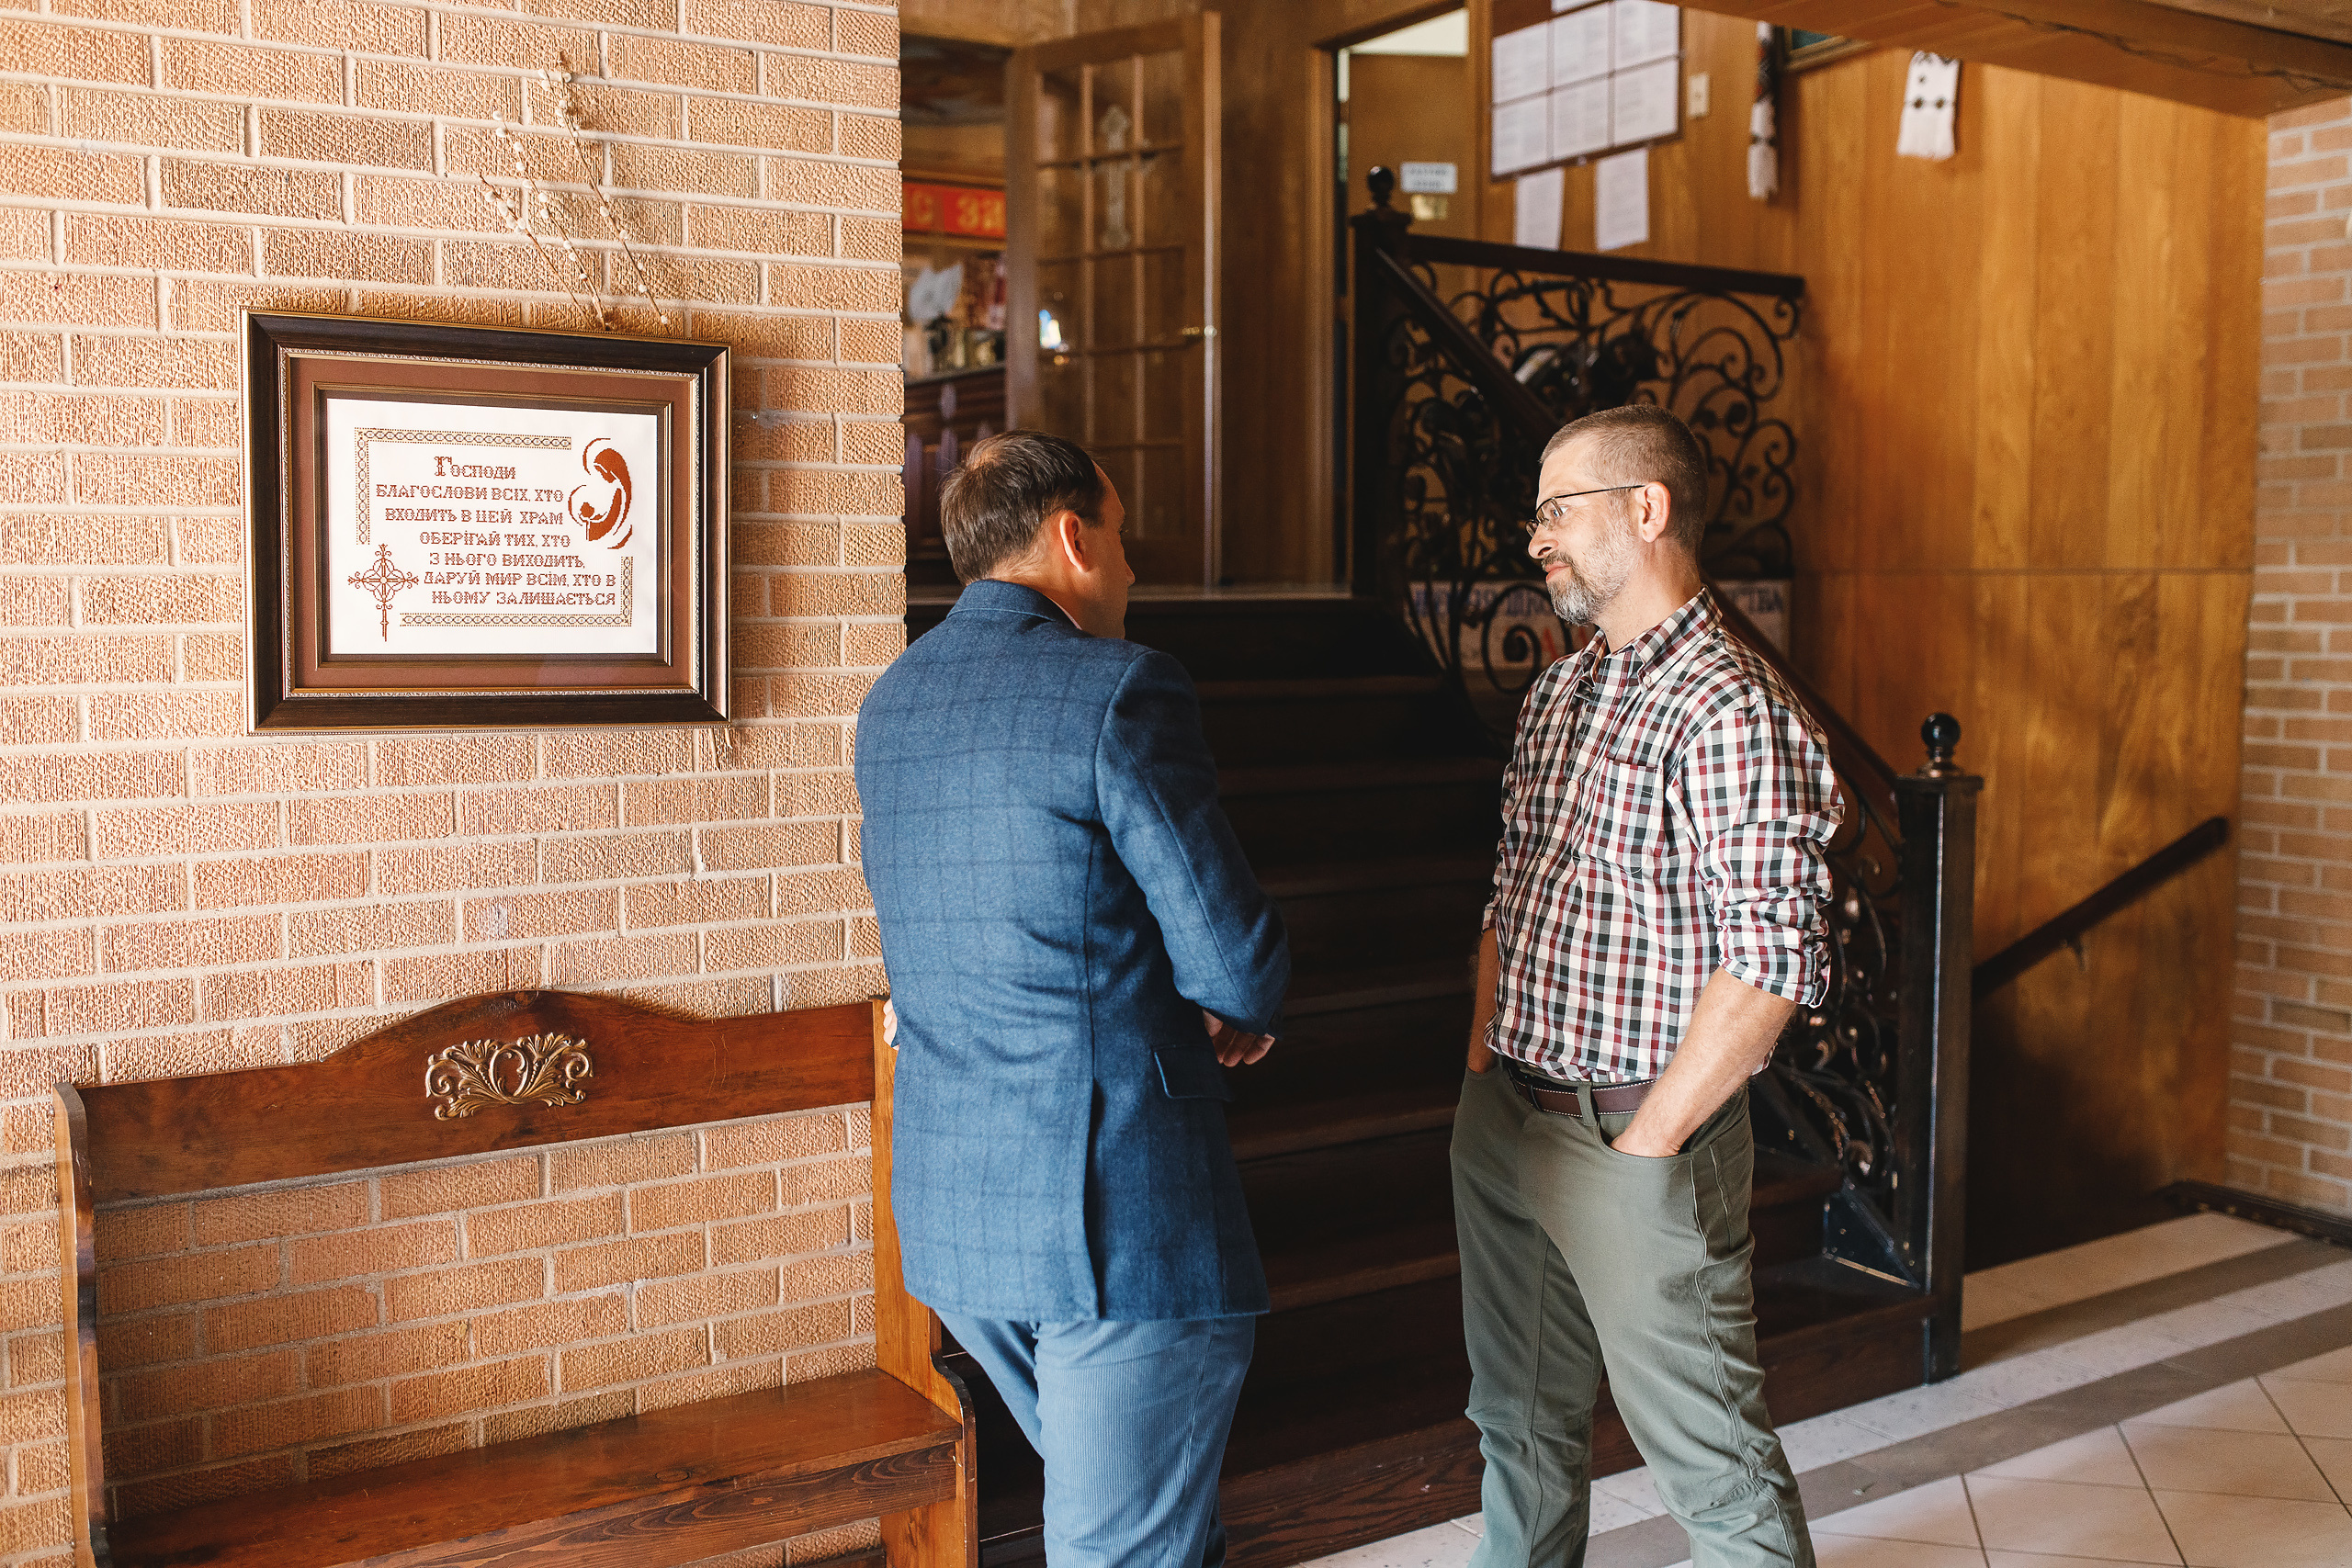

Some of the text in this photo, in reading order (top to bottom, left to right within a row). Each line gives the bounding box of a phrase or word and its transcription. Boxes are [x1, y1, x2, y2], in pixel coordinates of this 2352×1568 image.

[434, 457, 515, 479] Господи
[376, 484, 563, 502] БЛАГОСЛОВИ ВСІХ, ХТО
[385, 508, 563, 525] ВХОДИТЬ В ЦЕЙ ХРАМ
[420, 530, 571, 547] ОБЕРІГАЙ ТИХ, ХТО
[430, 553, 585, 569] З НЬОГО ВИХОДИТЬ,
[424, 570, 616, 587] ДАРУЙ МИР ВСІМ, ХТО В
[432, 592, 615, 605] НЬОМУ ЗАЛИШАЄТЬСЯ
